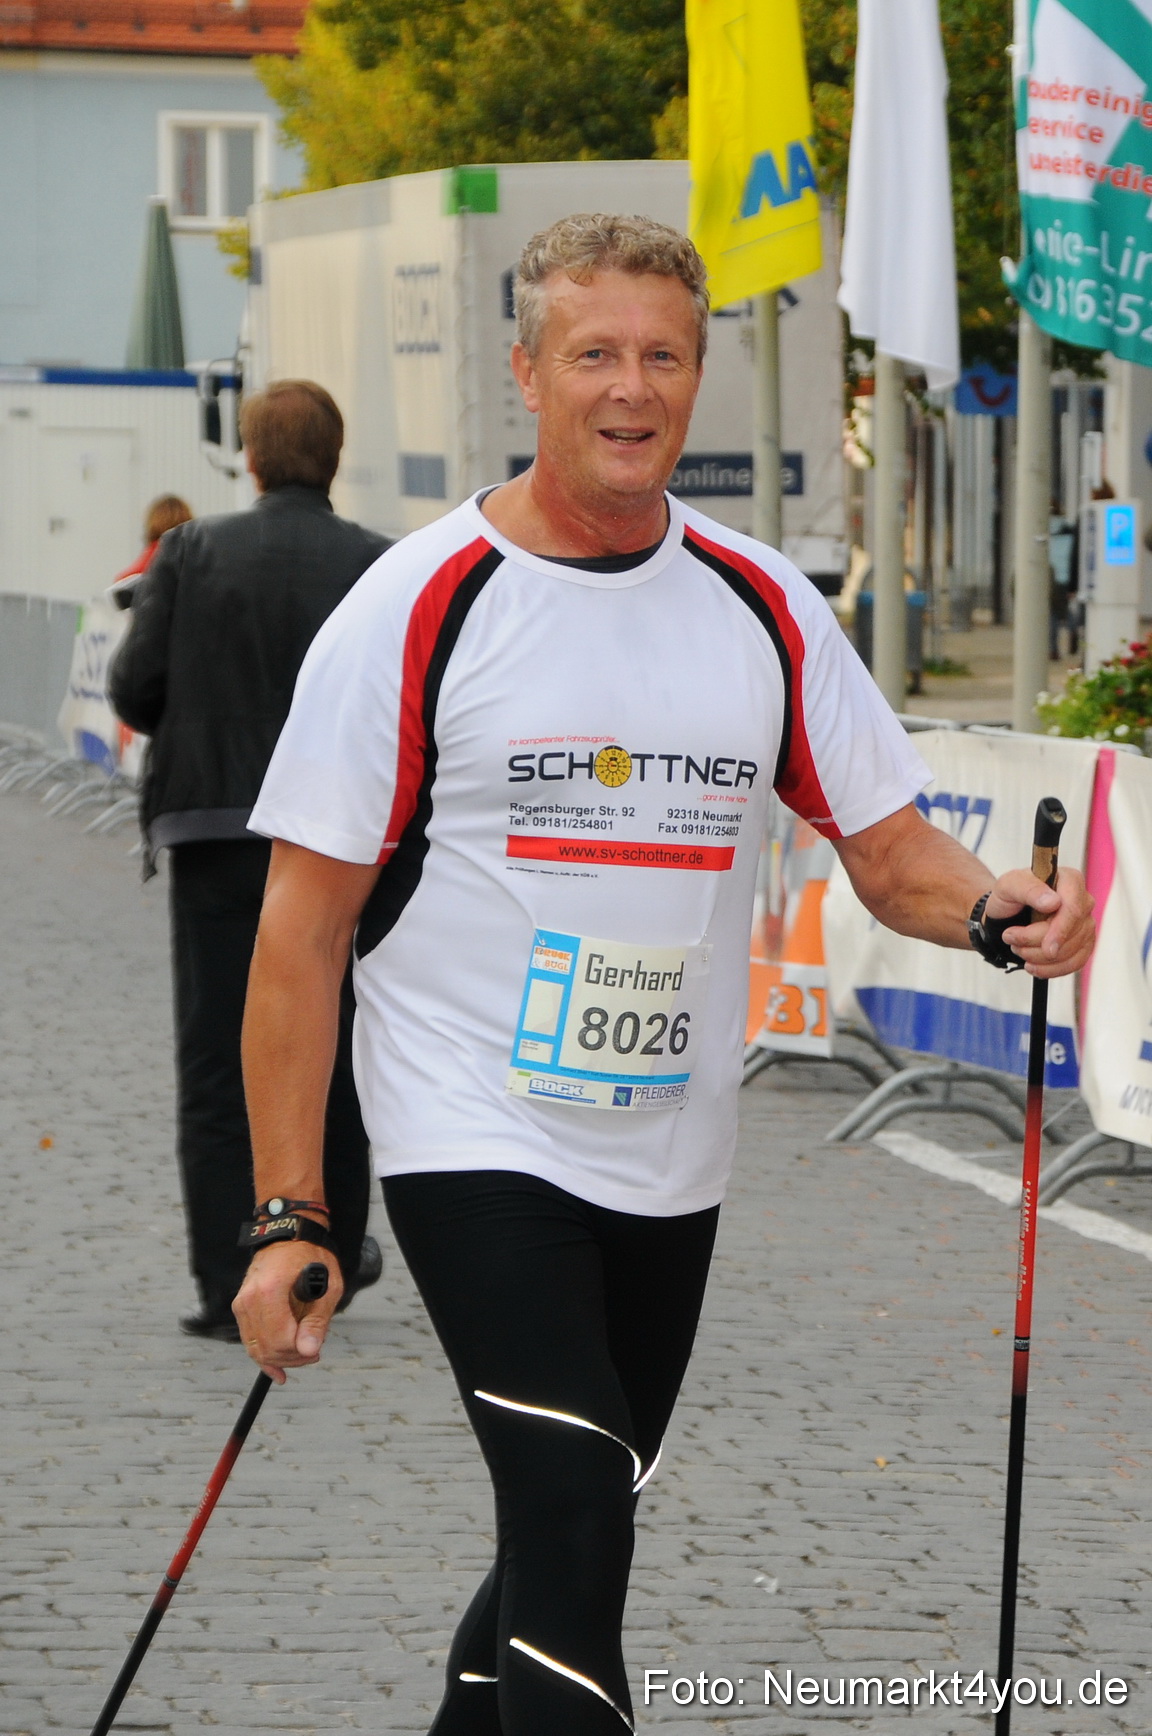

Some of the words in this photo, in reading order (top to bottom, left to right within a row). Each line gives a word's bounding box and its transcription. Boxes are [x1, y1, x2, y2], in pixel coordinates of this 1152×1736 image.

[509, 803, 595, 817] Regensburger
[599, 806, 618, 816] Str.
[622, 807, 635, 817] 92
[667, 809, 700, 820] 92318
[702, 810, 742, 823] Neumarkt
[509, 815, 528, 826] Tel.
[533, 817, 613, 830] 09181/254801
[658, 823, 678, 834] Fax
[559, 845, 704, 865] www.sv-schottner.de
[584, 953, 684, 991] Gerhard
[577, 1006, 691, 1056] 8026
[529, 1078, 584, 1097] BOCK
[634, 1084, 686, 1099] PFLEIDERER
